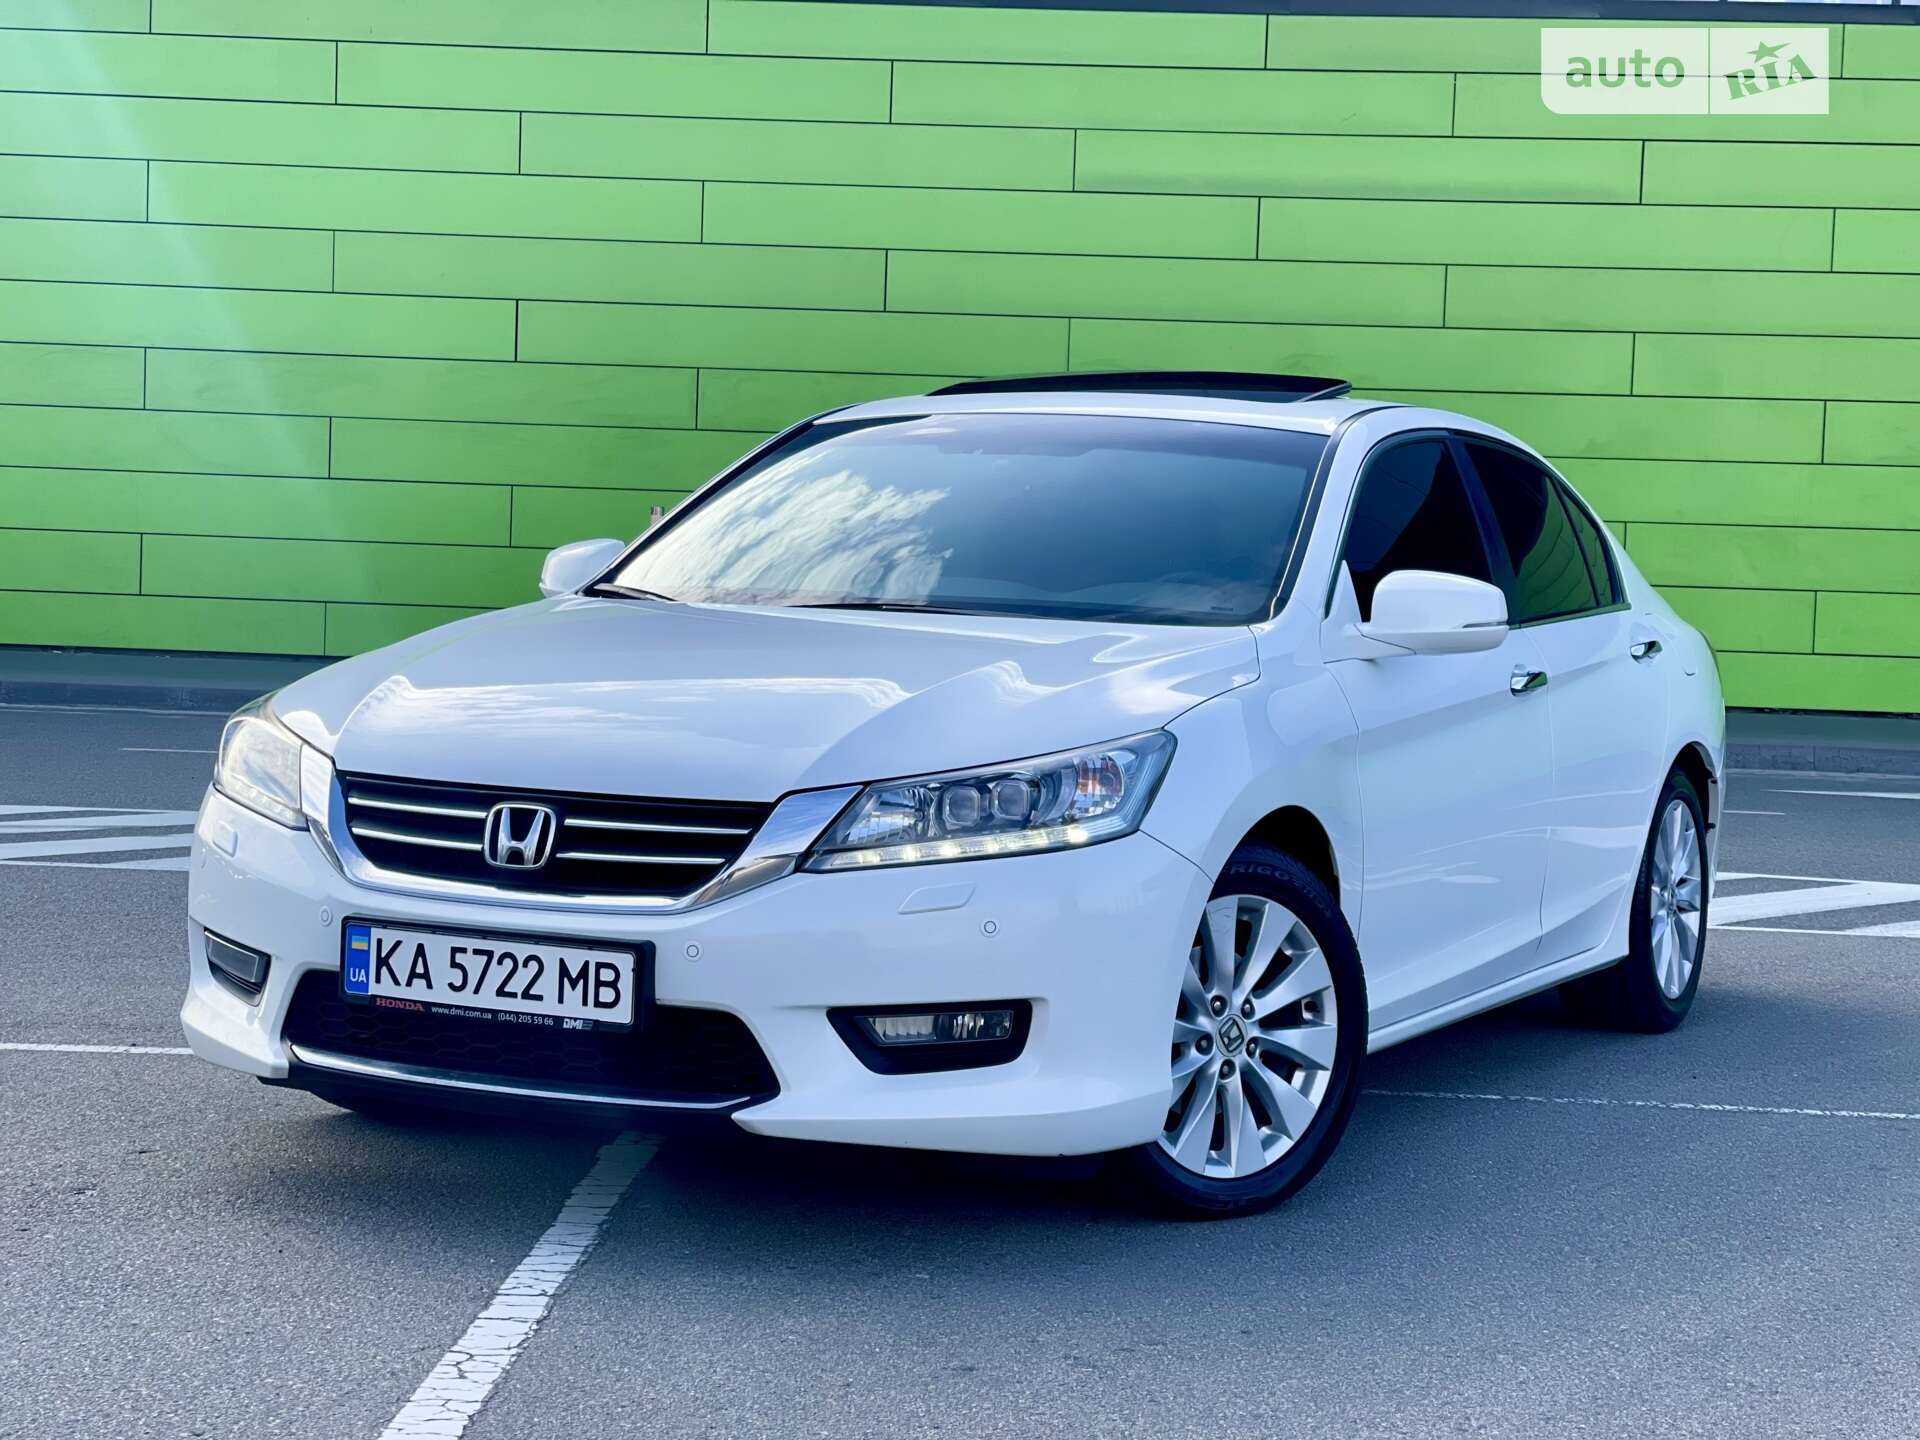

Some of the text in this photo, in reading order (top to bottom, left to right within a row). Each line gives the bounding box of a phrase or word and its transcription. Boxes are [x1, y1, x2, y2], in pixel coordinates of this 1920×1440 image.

[350, 967, 367, 984] UA
[375, 937, 621, 1009] KA 5722 MB
[375, 997, 426, 1012] HONDA
[431, 1004, 492, 1020] www.dmi.com.ua
[497, 1011, 517, 1024] (044)
[518, 1014, 532, 1024] 205
[533, 1016, 543, 1025] 59
